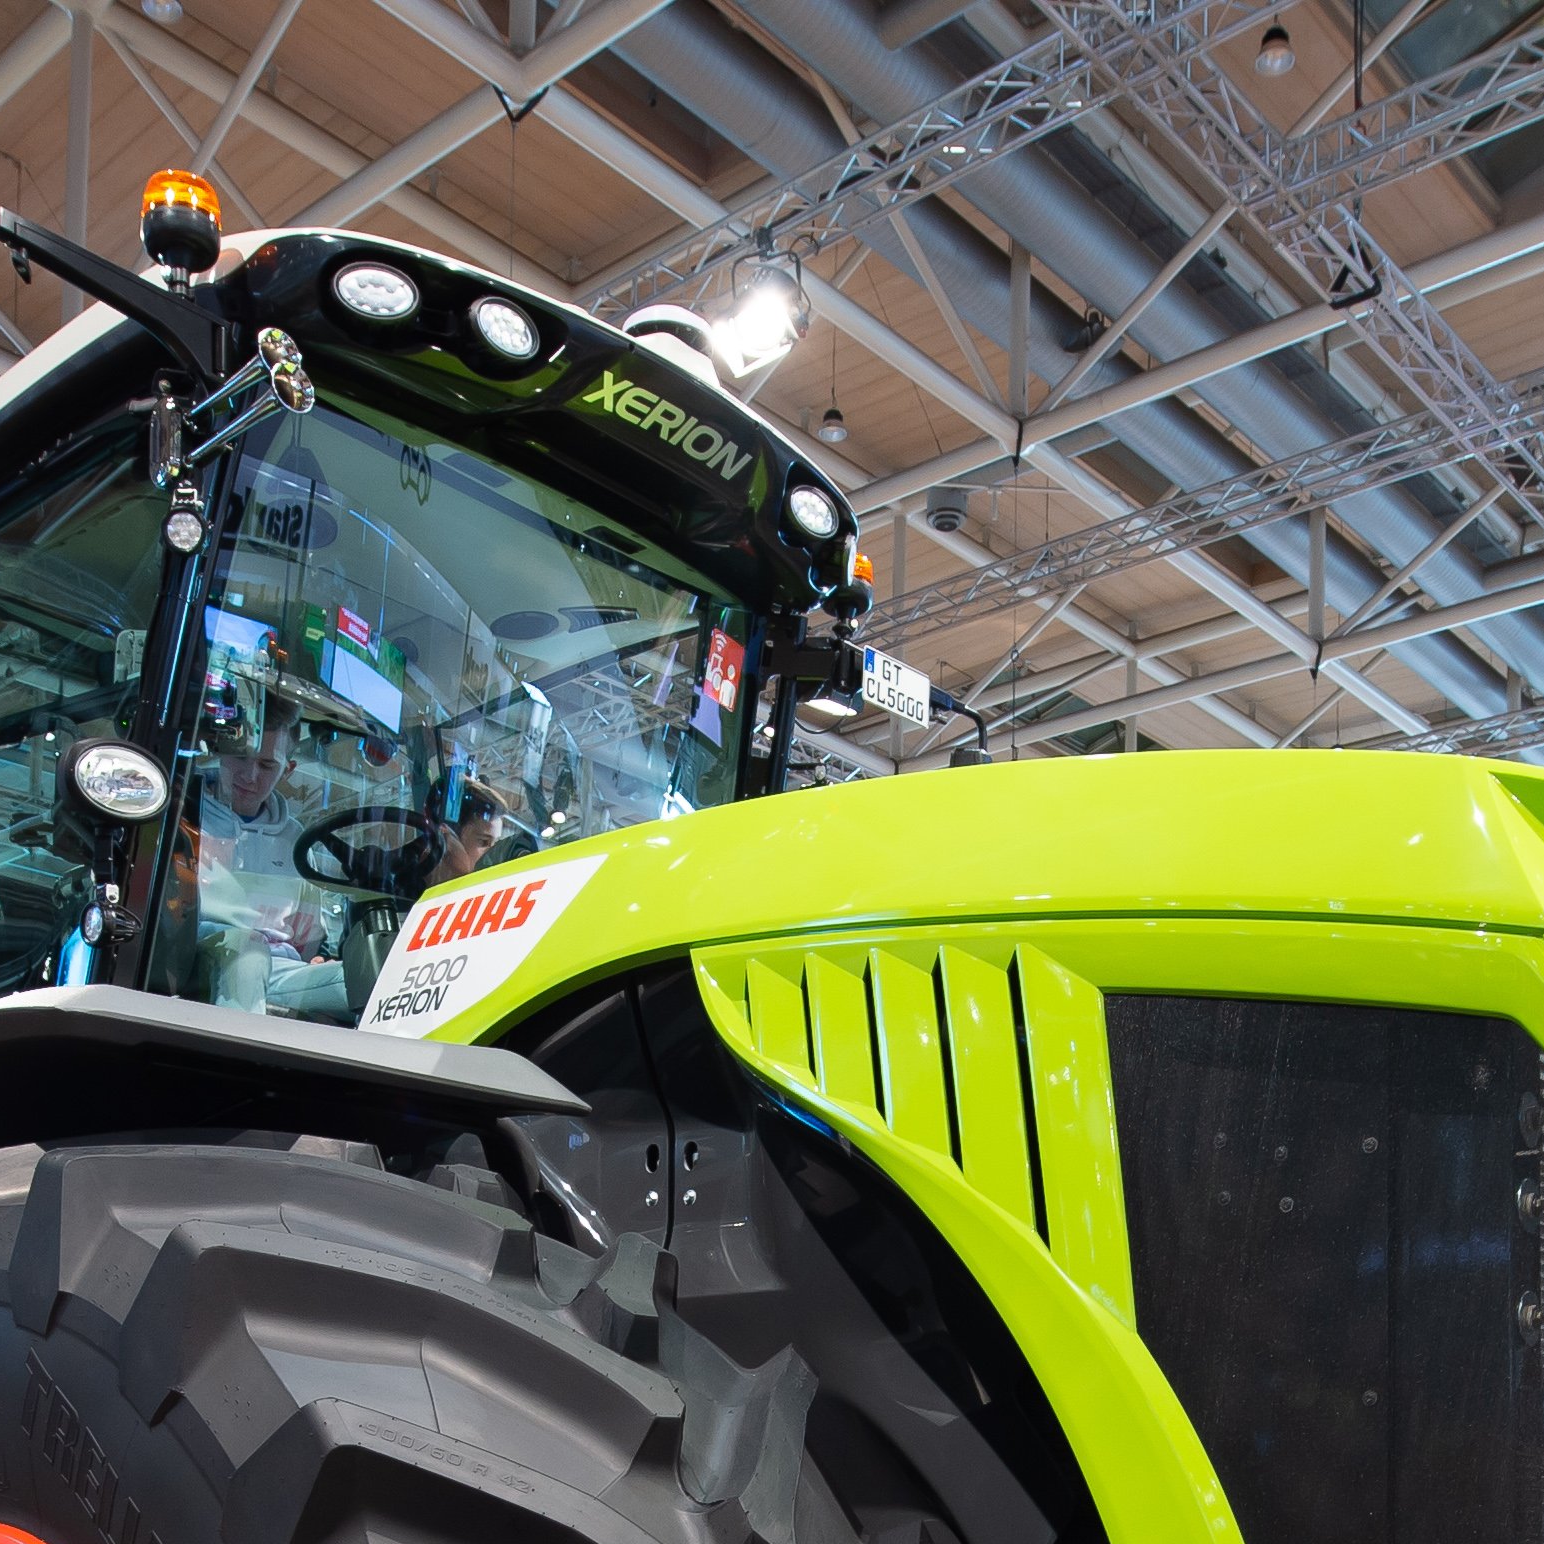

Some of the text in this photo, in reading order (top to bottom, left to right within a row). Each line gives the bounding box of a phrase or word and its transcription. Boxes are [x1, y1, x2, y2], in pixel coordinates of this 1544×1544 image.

[582, 370, 753, 481] XERION
[882, 659, 902, 686] GT
[866, 677, 924, 722] CL5000
[406, 879, 547, 952] CLAAS
[398, 954, 468, 993] 5000
[369, 984, 449, 1024] XERION
